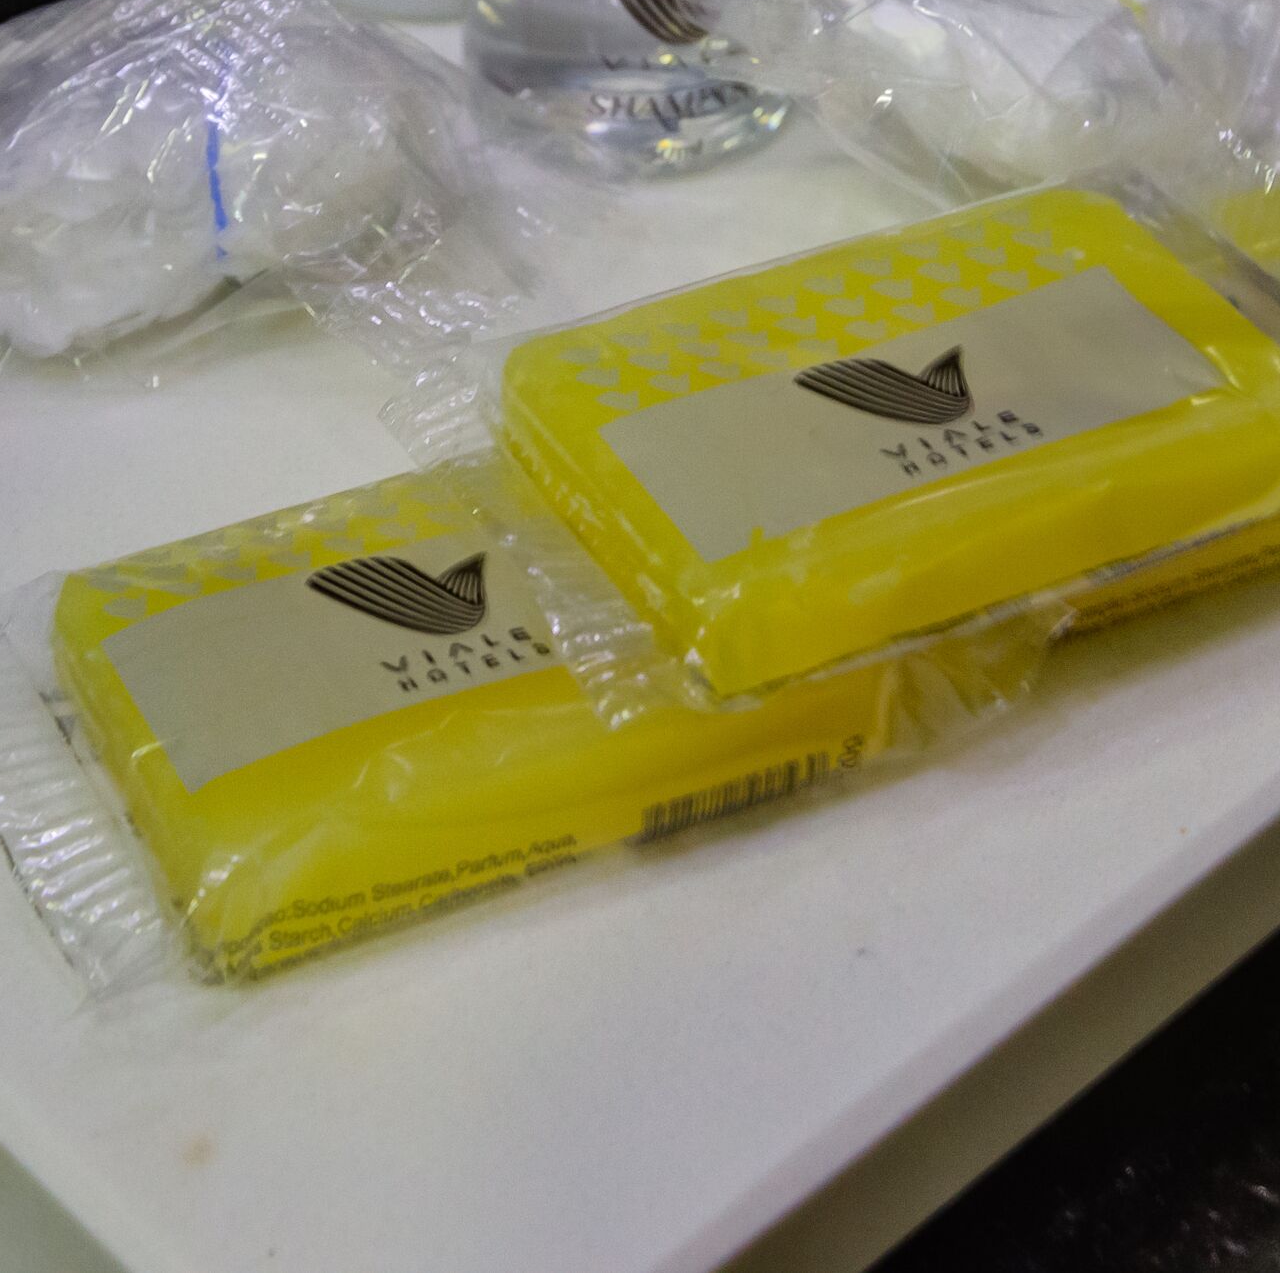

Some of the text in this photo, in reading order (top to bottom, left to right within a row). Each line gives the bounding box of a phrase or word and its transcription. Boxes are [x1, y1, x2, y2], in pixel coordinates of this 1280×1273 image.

[879, 410, 1019, 458] VIALE
[901, 423, 1043, 476] HOTELS
[380, 627, 531, 672] VIALE
[398, 642, 550, 692] HOTELS
